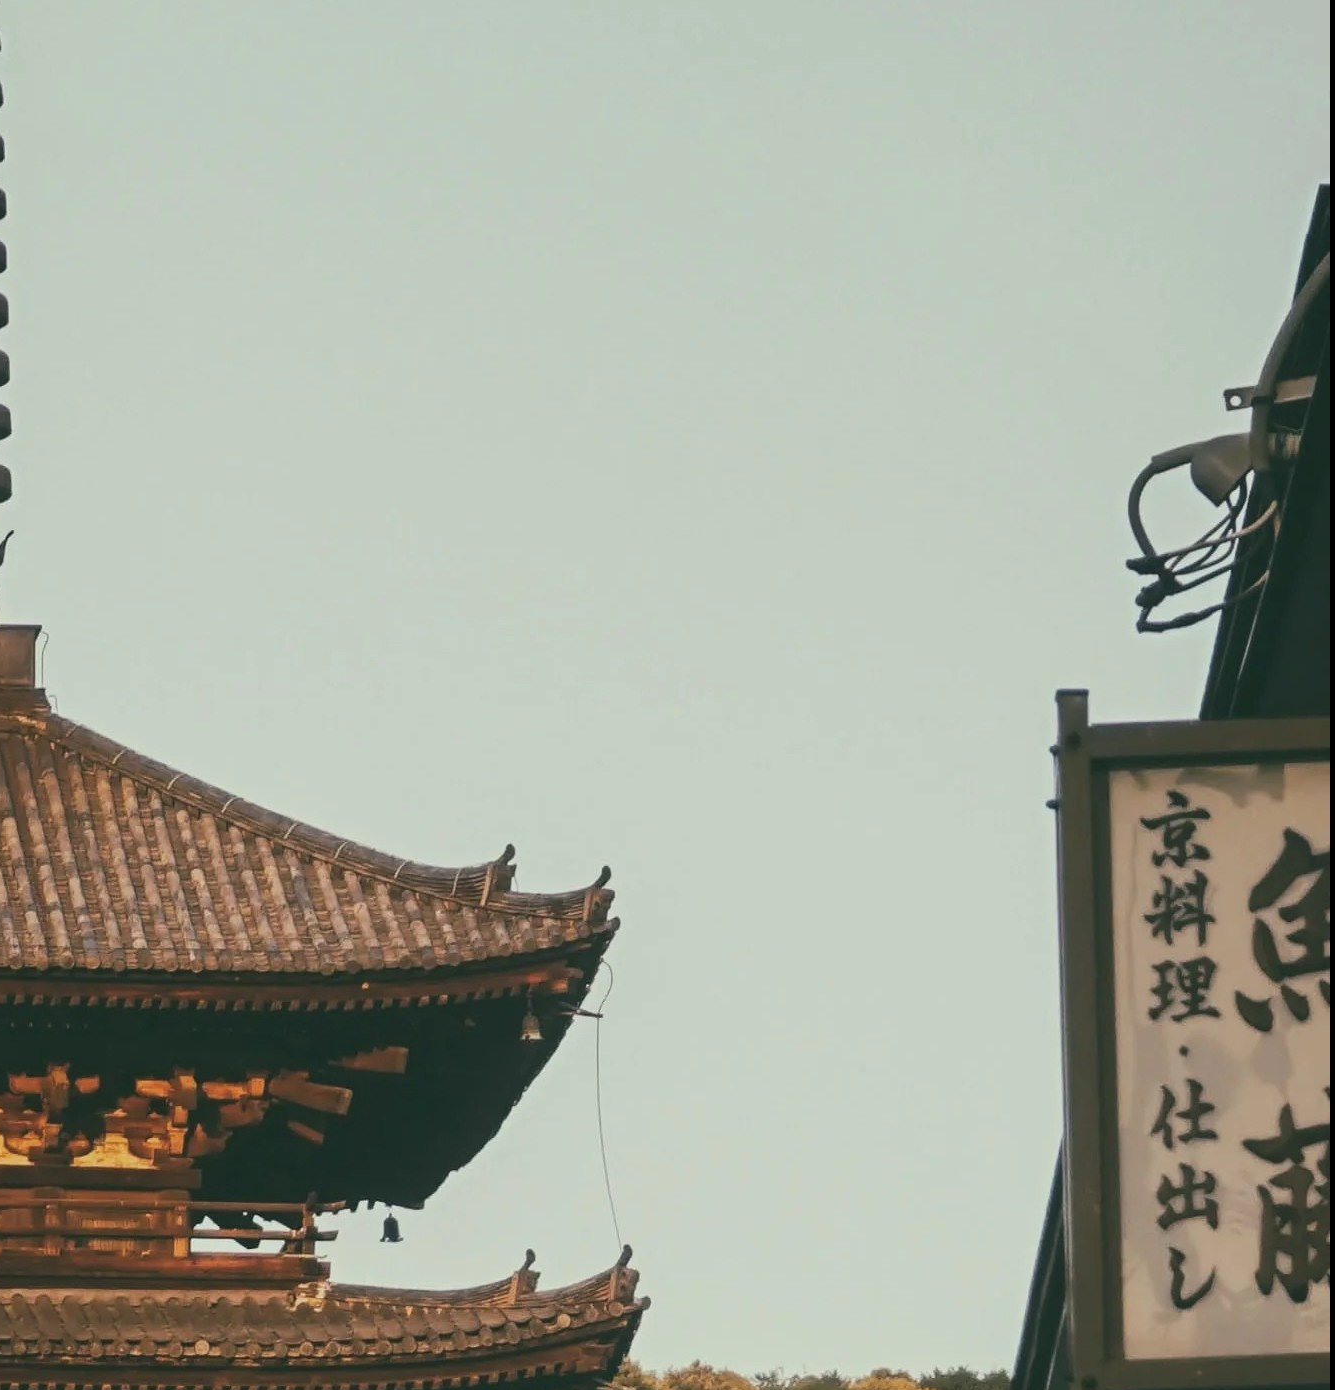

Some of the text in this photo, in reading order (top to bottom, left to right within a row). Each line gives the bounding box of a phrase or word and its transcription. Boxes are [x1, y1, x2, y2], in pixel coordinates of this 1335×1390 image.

[1141, 790, 1221, 1310] 京料理・仕出し
